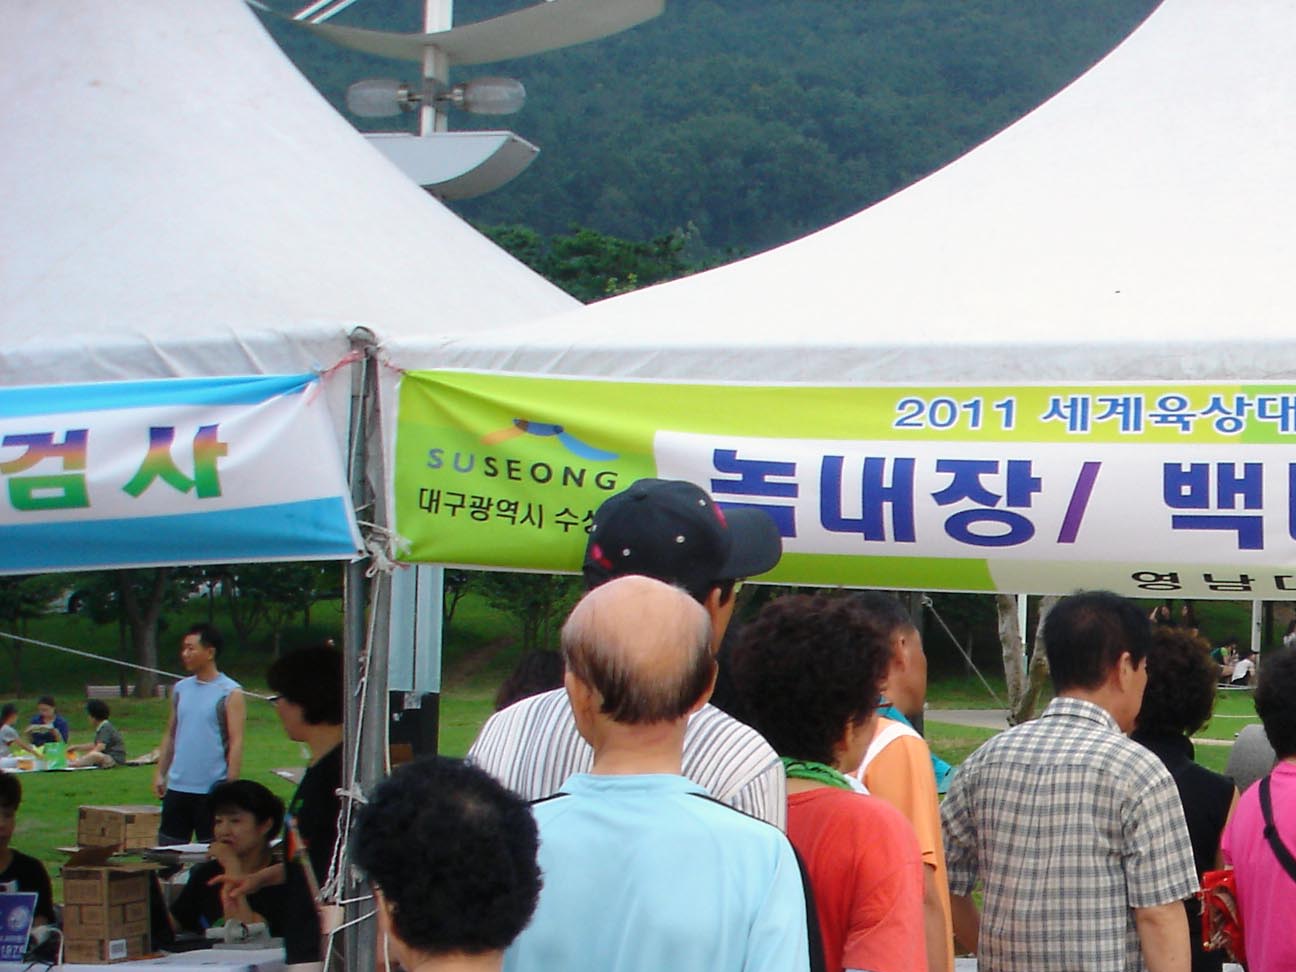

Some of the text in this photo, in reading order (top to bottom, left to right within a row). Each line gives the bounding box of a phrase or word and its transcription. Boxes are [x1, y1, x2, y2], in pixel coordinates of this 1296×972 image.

[894, 398, 1016, 429] 2011
[0, 422, 228, 512] 검사
[426, 448, 619, 491] SUSEONG
[418, 487, 544, 529] 대구광역시
